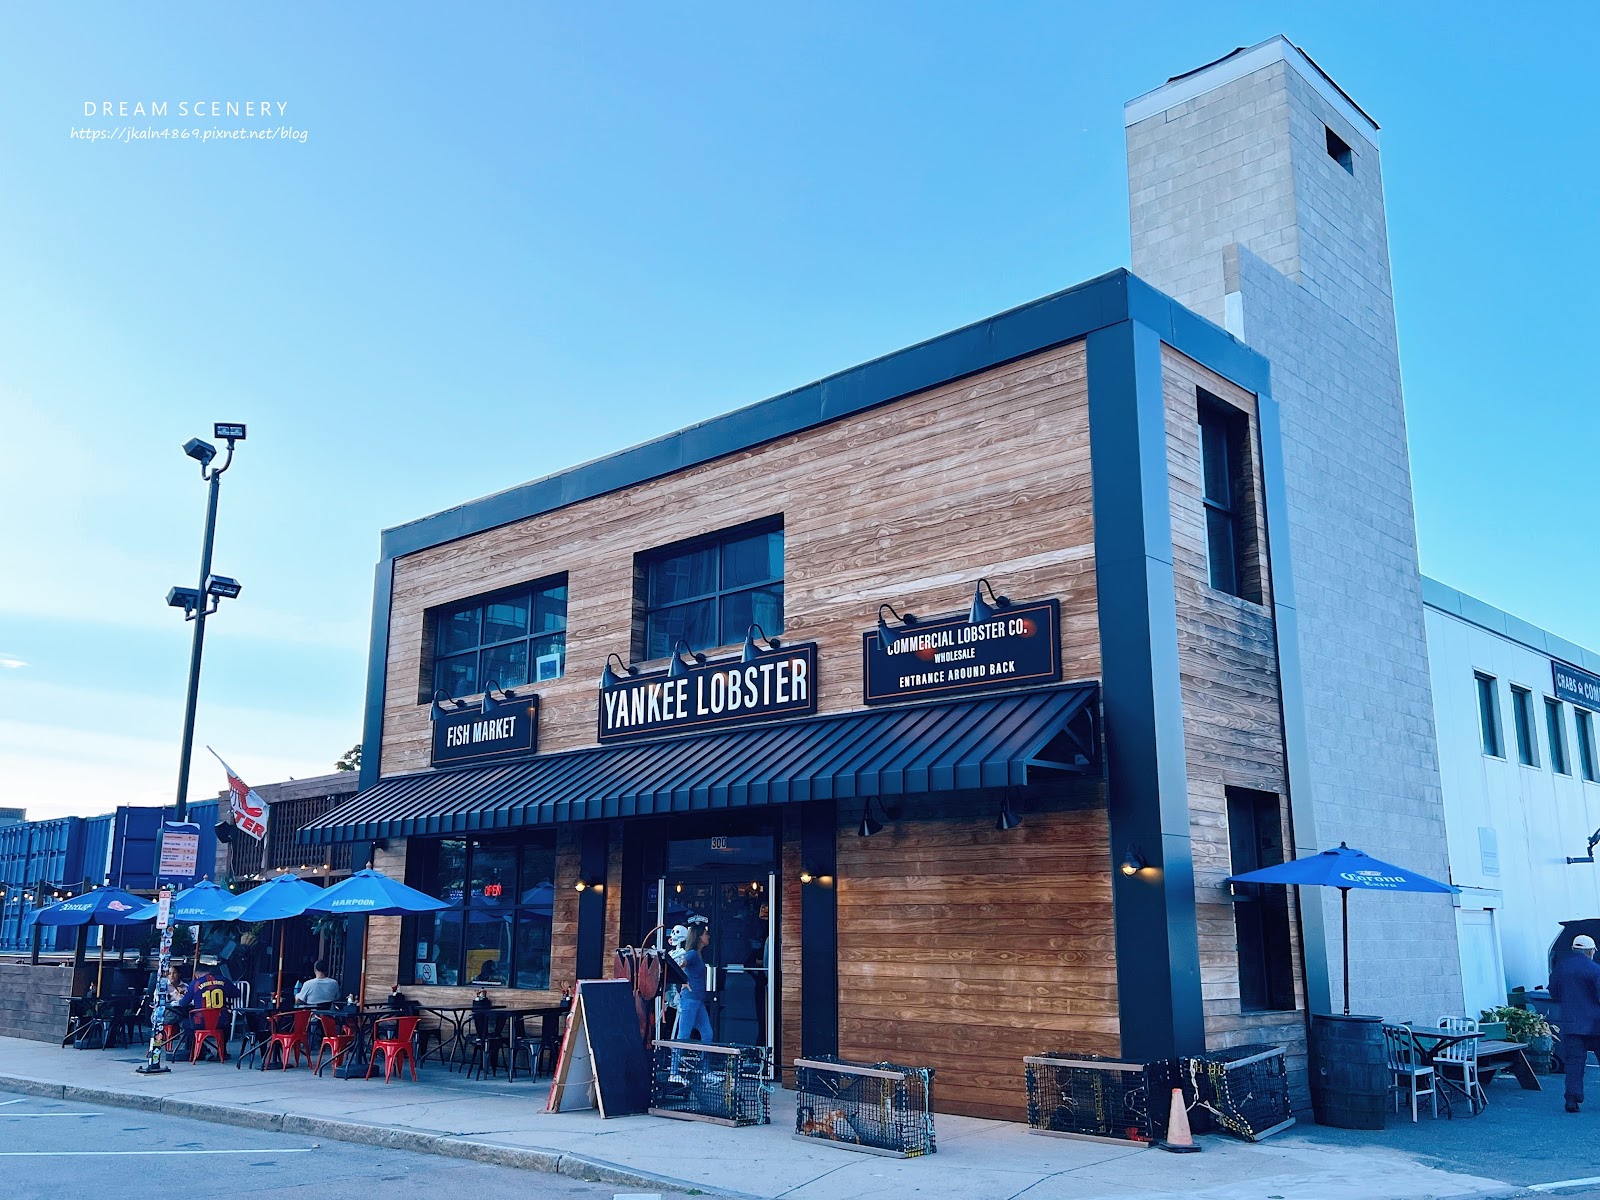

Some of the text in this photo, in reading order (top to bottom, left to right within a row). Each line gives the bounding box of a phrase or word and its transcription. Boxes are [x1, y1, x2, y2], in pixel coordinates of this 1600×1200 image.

[887, 618, 1028, 655] COMMERCIAL LOBSTER CO.
[934, 647, 976, 664] WHOLESALE
[899, 660, 1016, 688] ENTRANCE AROUND BACK
[604, 658, 807, 730] YANKEE LOBSTER
[1557, 673, 1600, 702] CRABS COM
[446, 715, 517, 748] FISH MARKET
[712, 837, 726, 849] 300
[1340, 872, 1406, 883] Corona
[484, 885, 502, 896] OPEN
[332, 899, 375, 907] HARPOON
[202, 988, 223, 1008] 10
